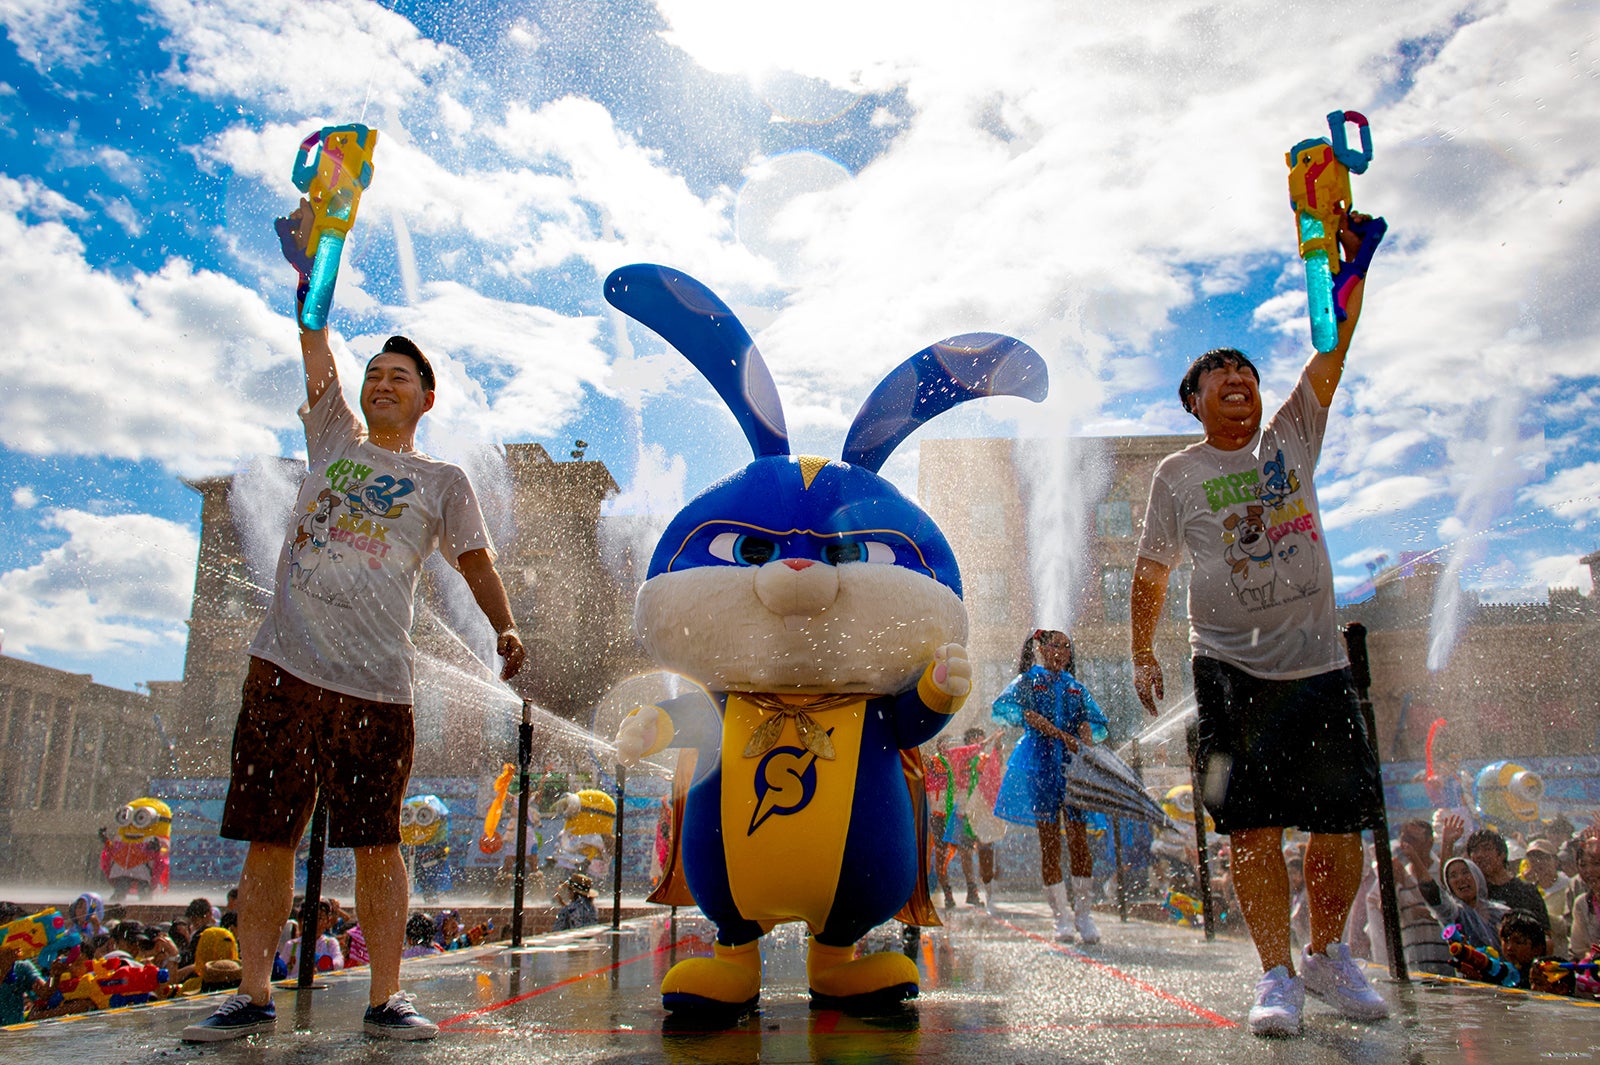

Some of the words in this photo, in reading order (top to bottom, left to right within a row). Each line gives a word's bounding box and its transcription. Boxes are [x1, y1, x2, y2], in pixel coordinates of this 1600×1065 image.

[1202, 468, 1259, 495] SNOW
[1207, 485, 1256, 512] BALL
[1270, 498, 1309, 527] MAX
[336, 513, 391, 541] MAX
[1267, 513, 1316, 542] GIDGET
